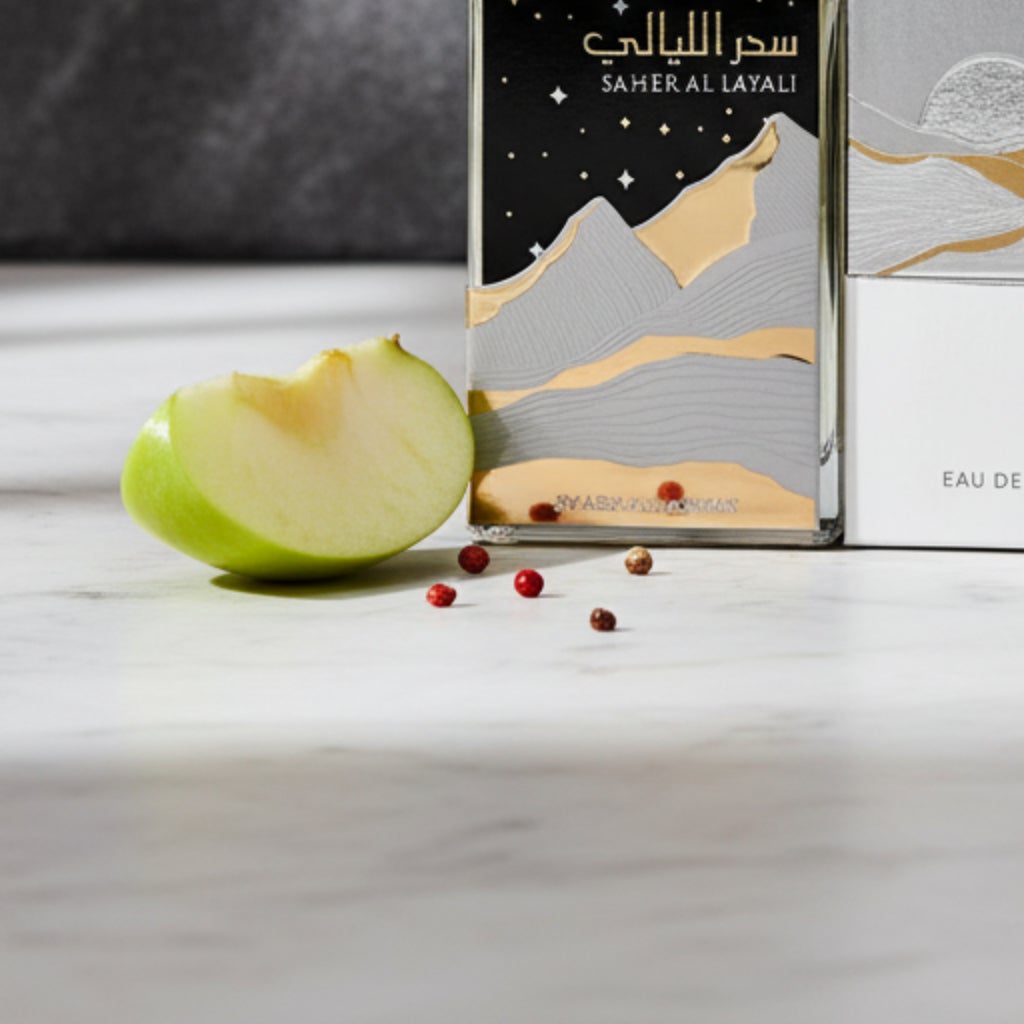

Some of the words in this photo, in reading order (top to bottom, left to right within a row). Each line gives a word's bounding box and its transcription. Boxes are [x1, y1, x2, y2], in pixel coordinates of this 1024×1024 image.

[601, 73, 680, 93] SAHER
[685, 74, 714, 93] AL
[721, 74, 797, 93] LAYALI
[943, 471, 984, 489] EAU
[993, 472, 1021, 489] DE
